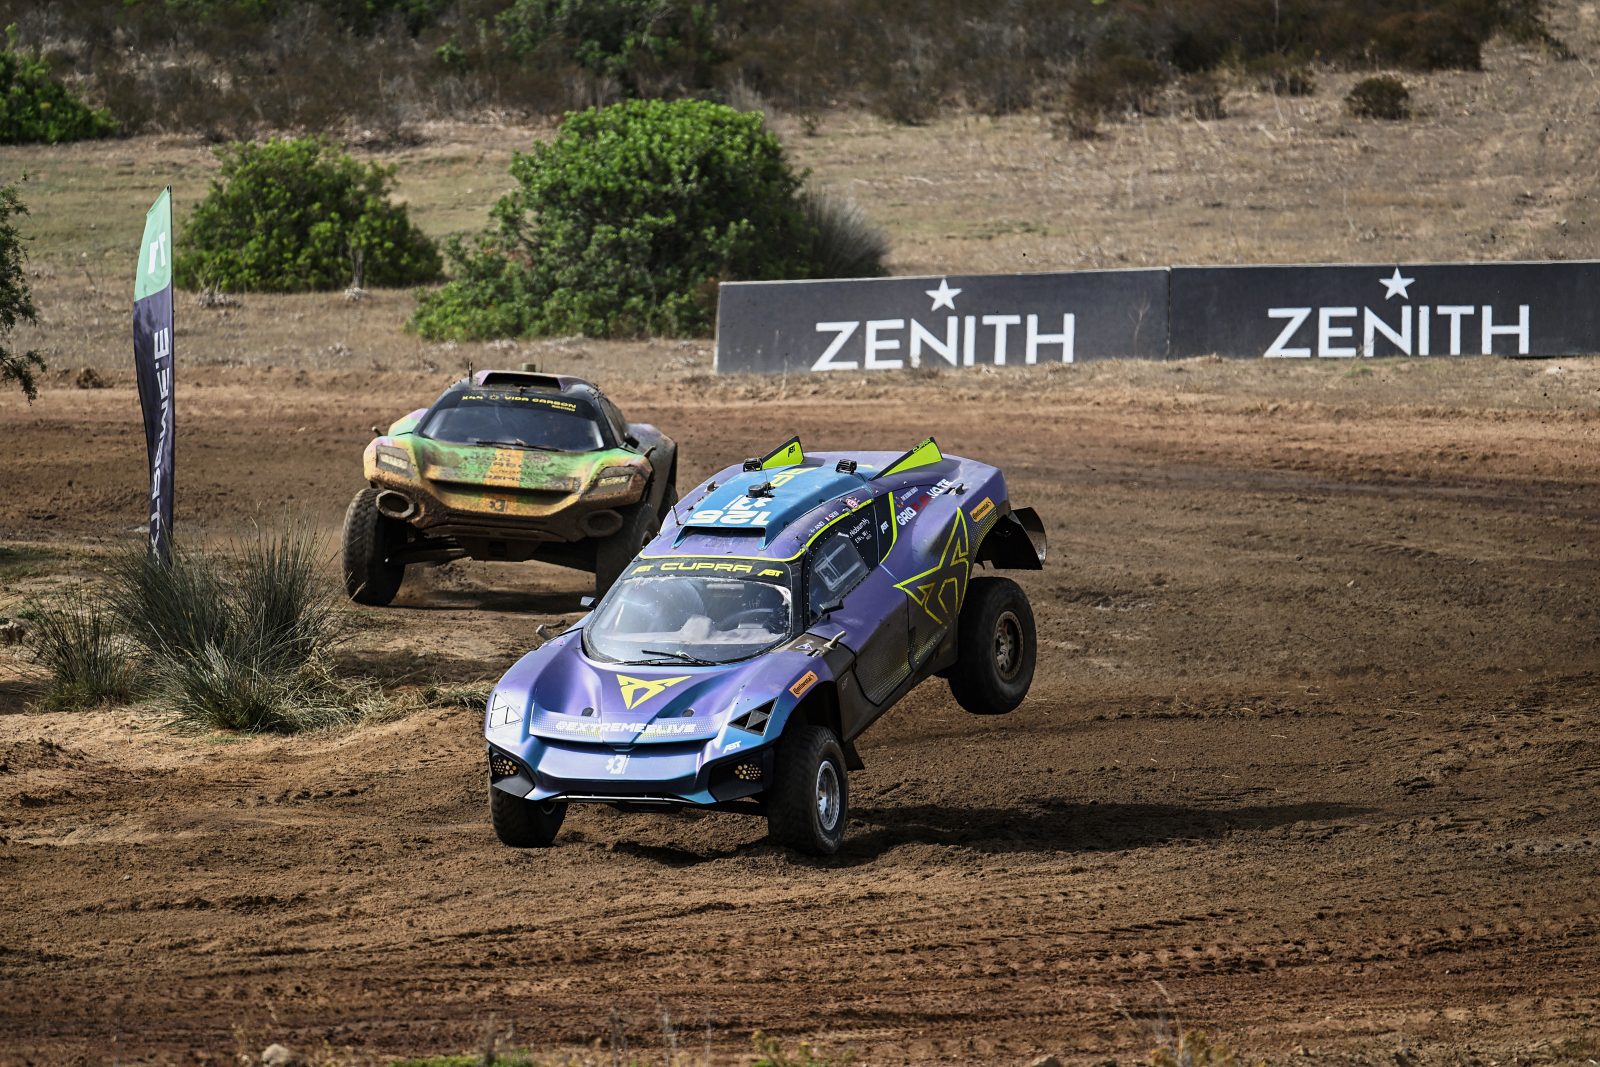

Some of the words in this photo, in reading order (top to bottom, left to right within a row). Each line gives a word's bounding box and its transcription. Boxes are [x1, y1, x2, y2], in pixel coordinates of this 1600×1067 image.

[1264, 304, 1530, 358] ZENITH
[811, 313, 1075, 371] ZENITH
[532, 398, 577, 409] CARBON
[660, 562, 754, 574] CUPRA
[757, 568, 784, 577] ABT
[792, 675, 813, 695] Continental
[722, 740, 742, 754] ABT
